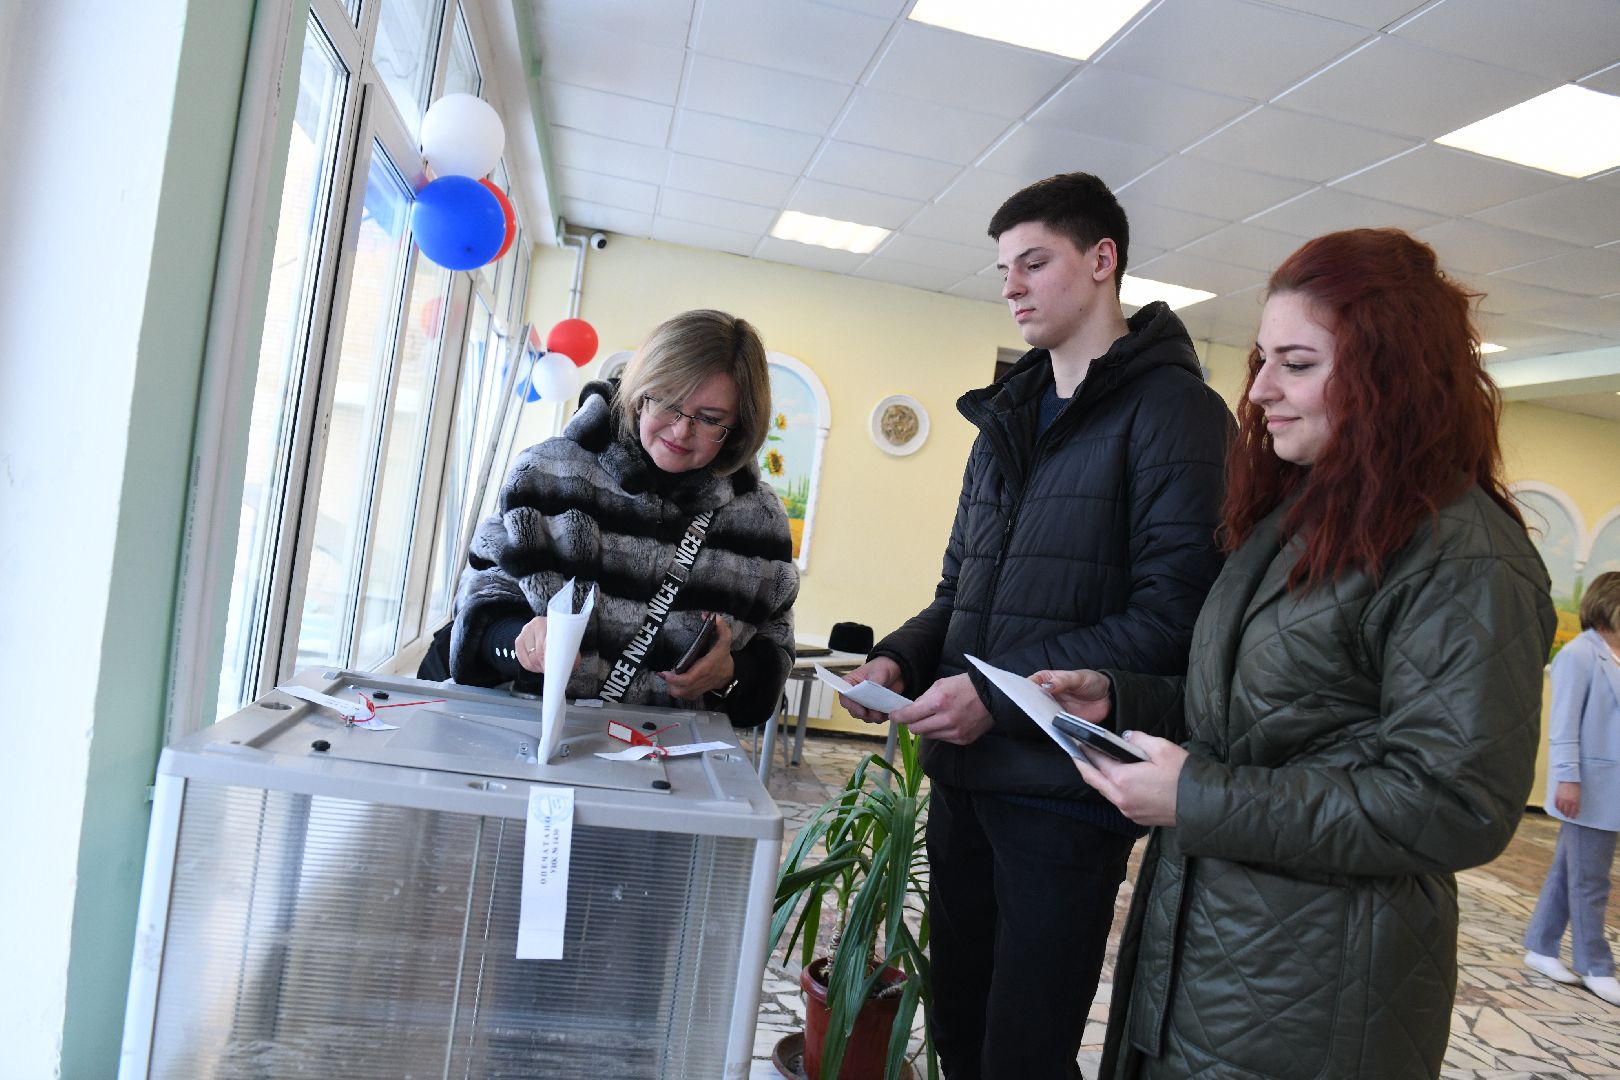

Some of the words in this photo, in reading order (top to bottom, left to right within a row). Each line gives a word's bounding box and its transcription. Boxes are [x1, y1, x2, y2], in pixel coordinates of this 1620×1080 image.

[600, 660, 636, 703] NICE
[623, 622, 658, 664] NICE
[648, 580, 678, 623] NICE
[674, 531, 702, 571] NICE
[692, 510, 713, 535] NIC
[540, 816, 551, 885] ОПЕЧАТАНО
